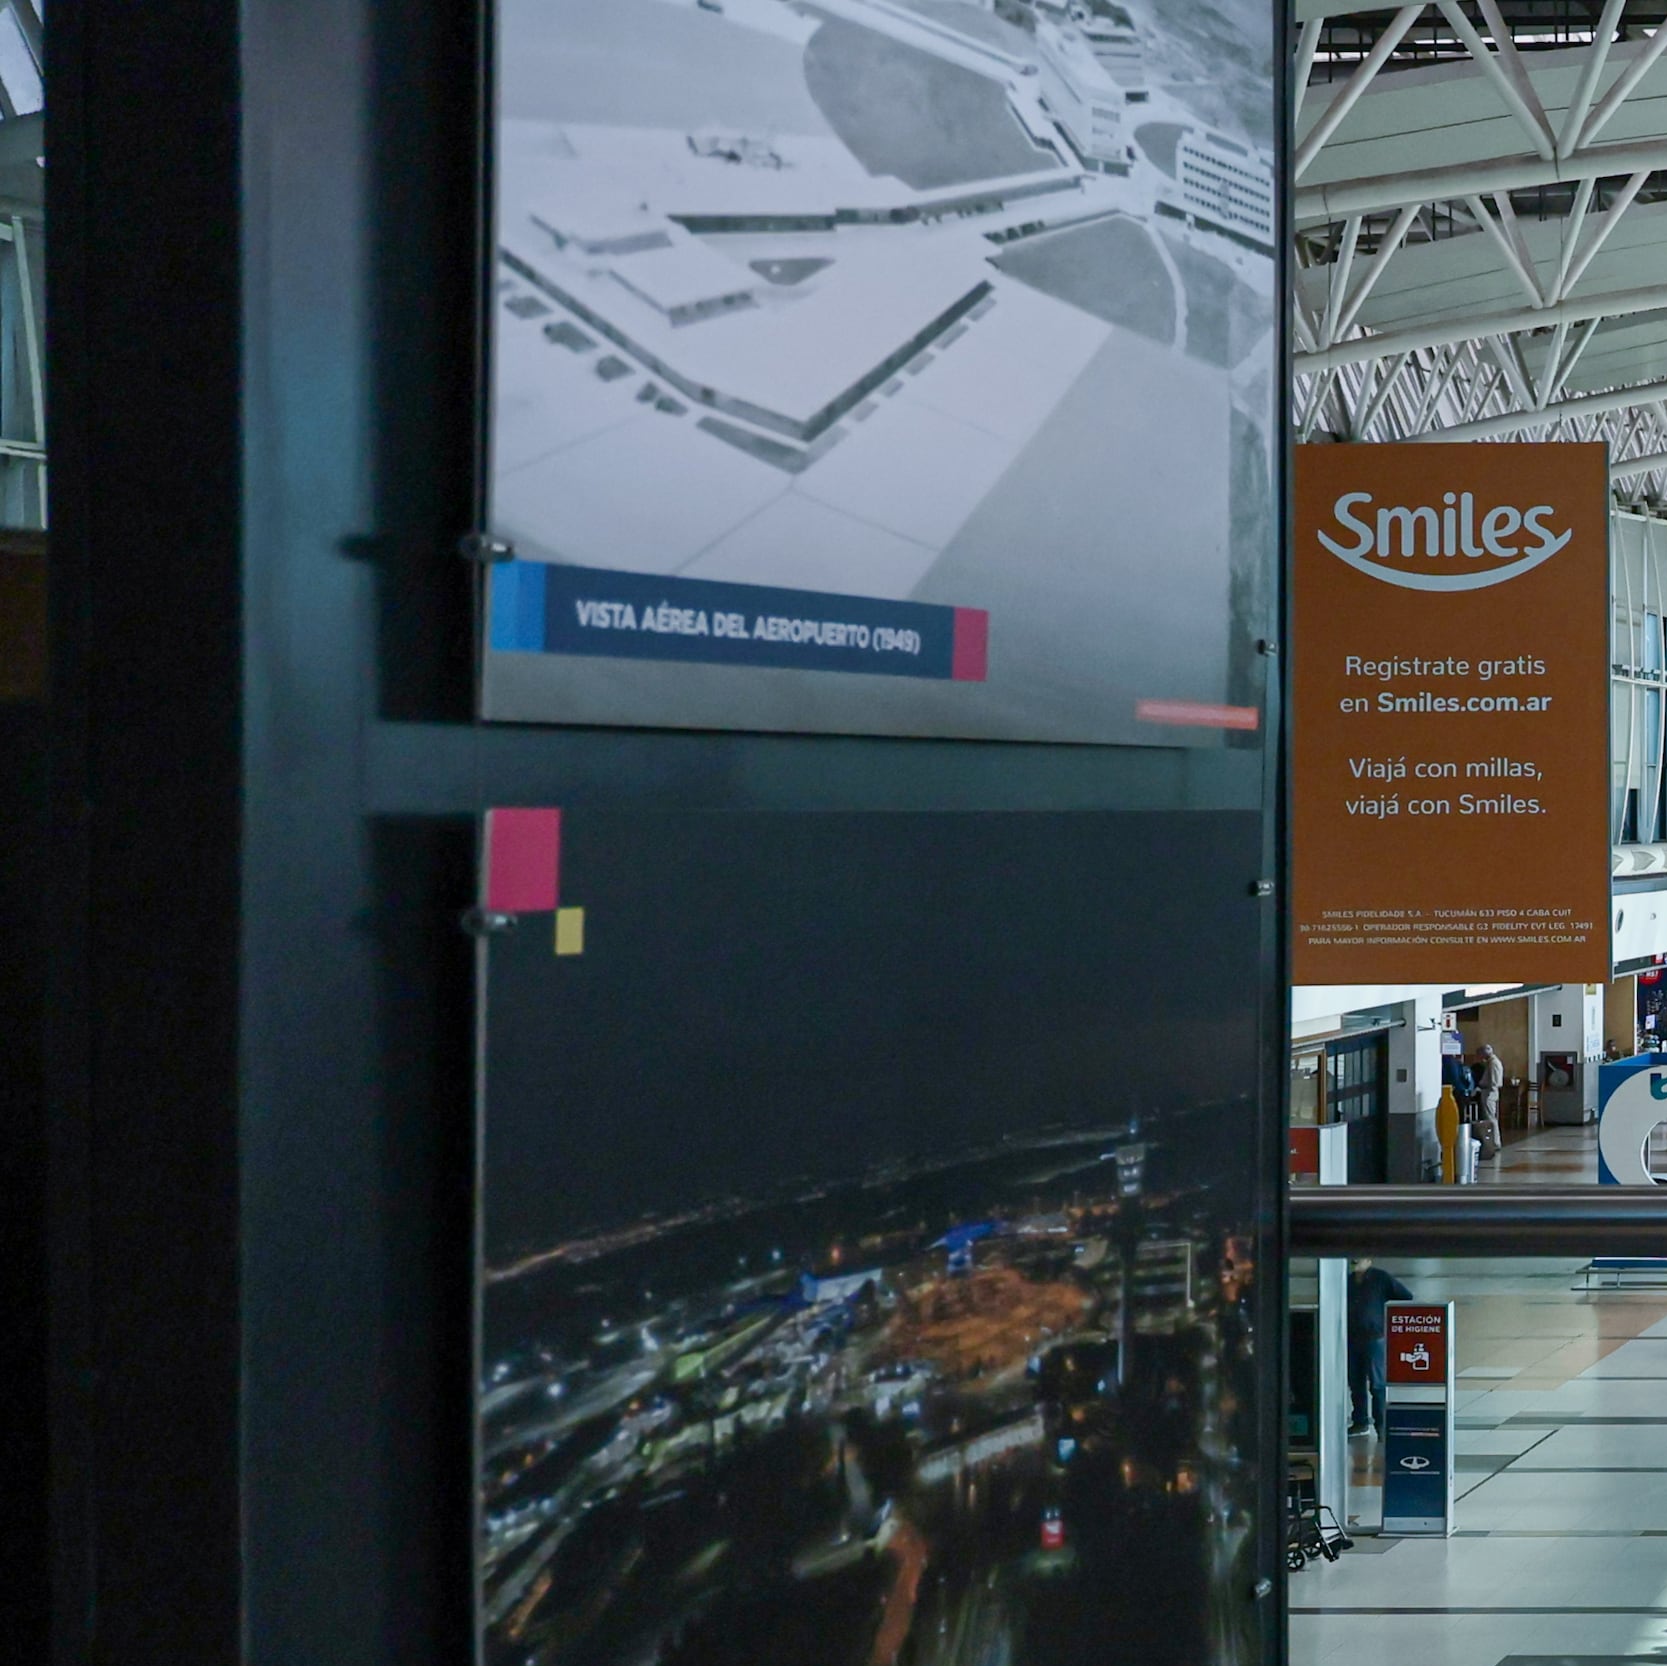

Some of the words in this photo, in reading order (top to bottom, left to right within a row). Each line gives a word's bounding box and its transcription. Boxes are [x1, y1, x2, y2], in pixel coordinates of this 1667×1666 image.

[1333, 490, 1555, 563] Smiles
[575, 598, 637, 633] VISTA
[640, 600, 709, 637] AÉREA
[712, 610, 749, 641] DEL
[752, 612, 870, 650] AEROPUERTO
[872, 625, 921, 657] (1949)
[1345, 655, 1470, 682] Registrate
[1477, 654, 1546, 682] gratis
[1339, 696, 1369, 713] en
[1377, 692, 1552, 713] Smiles.com.ar
[1349, 757, 1407, 782] Viajá
[1415, 761, 1457, 778] con
[1466, 757, 1544, 782] millas,
[1345, 794, 1400, 819] viajá
[1407, 798, 1451, 814] con
[1459, 793, 1547, 814] Smiles.
[1391, 1313, 1441, 1325] ESTACIÓN
[1405, 1325, 1441, 1333] HIGIENE
